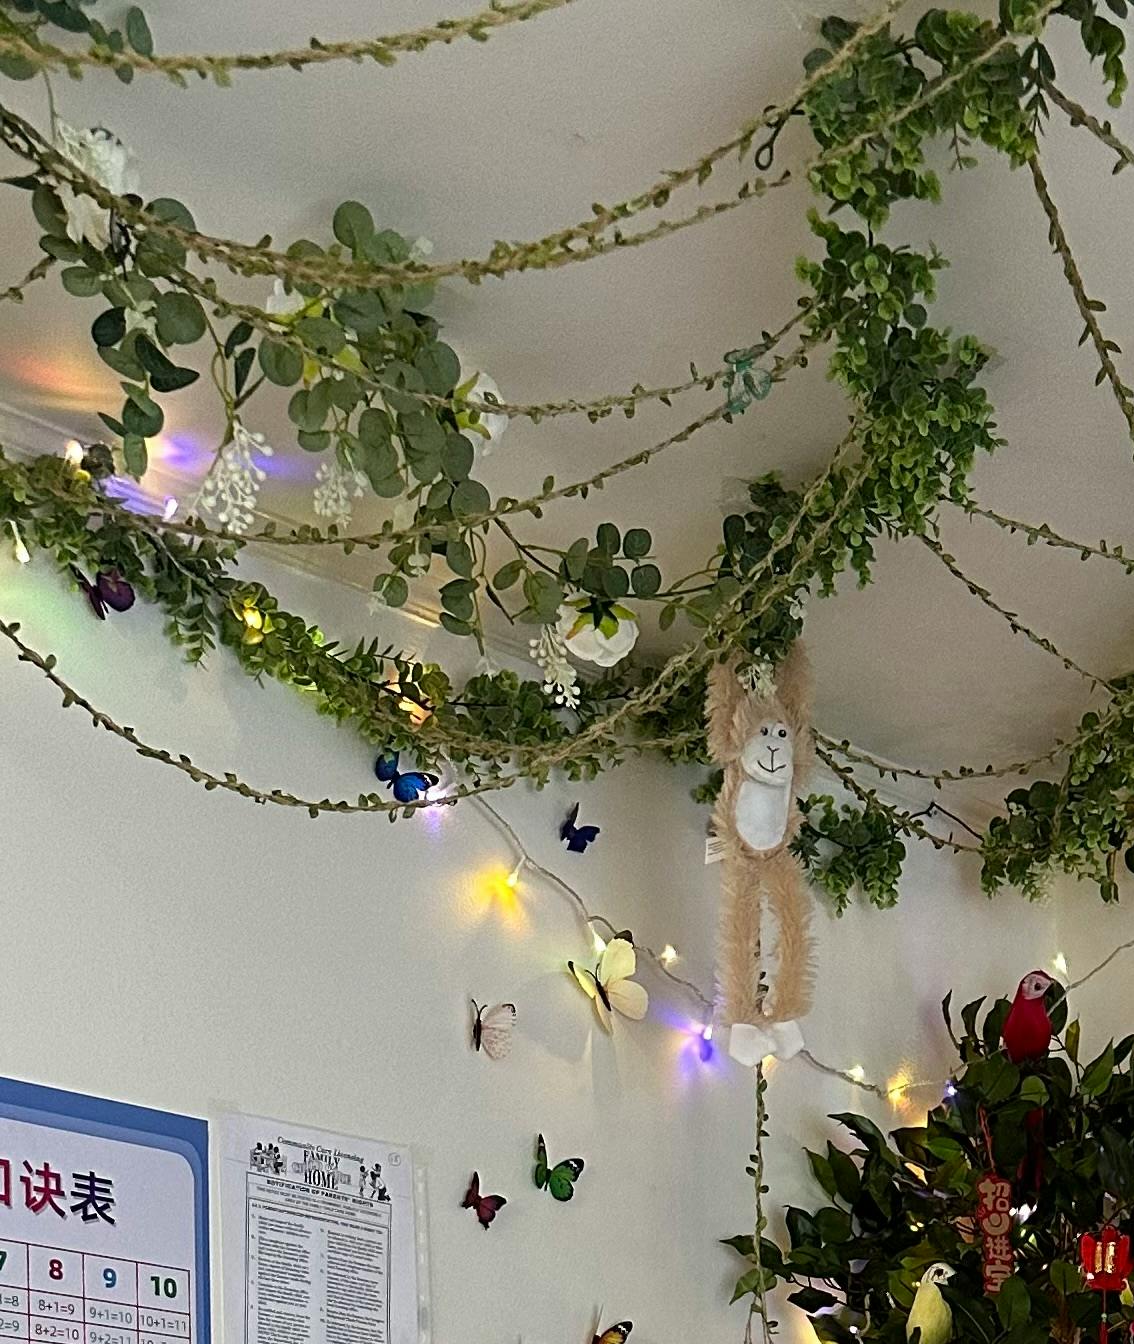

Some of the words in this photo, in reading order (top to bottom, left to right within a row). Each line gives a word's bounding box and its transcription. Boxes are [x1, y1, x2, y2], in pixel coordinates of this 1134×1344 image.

[0, 1158, 116, 1225] 诀表
[50, 1258, 64, 1280] 8
[102, 1268, 118, 1288] 9
[150, 1276, 178, 1298] 10
[38, 1299, 75, 1315] 8+1=9
[35, 1324, 80, 1340] 8+2=10
